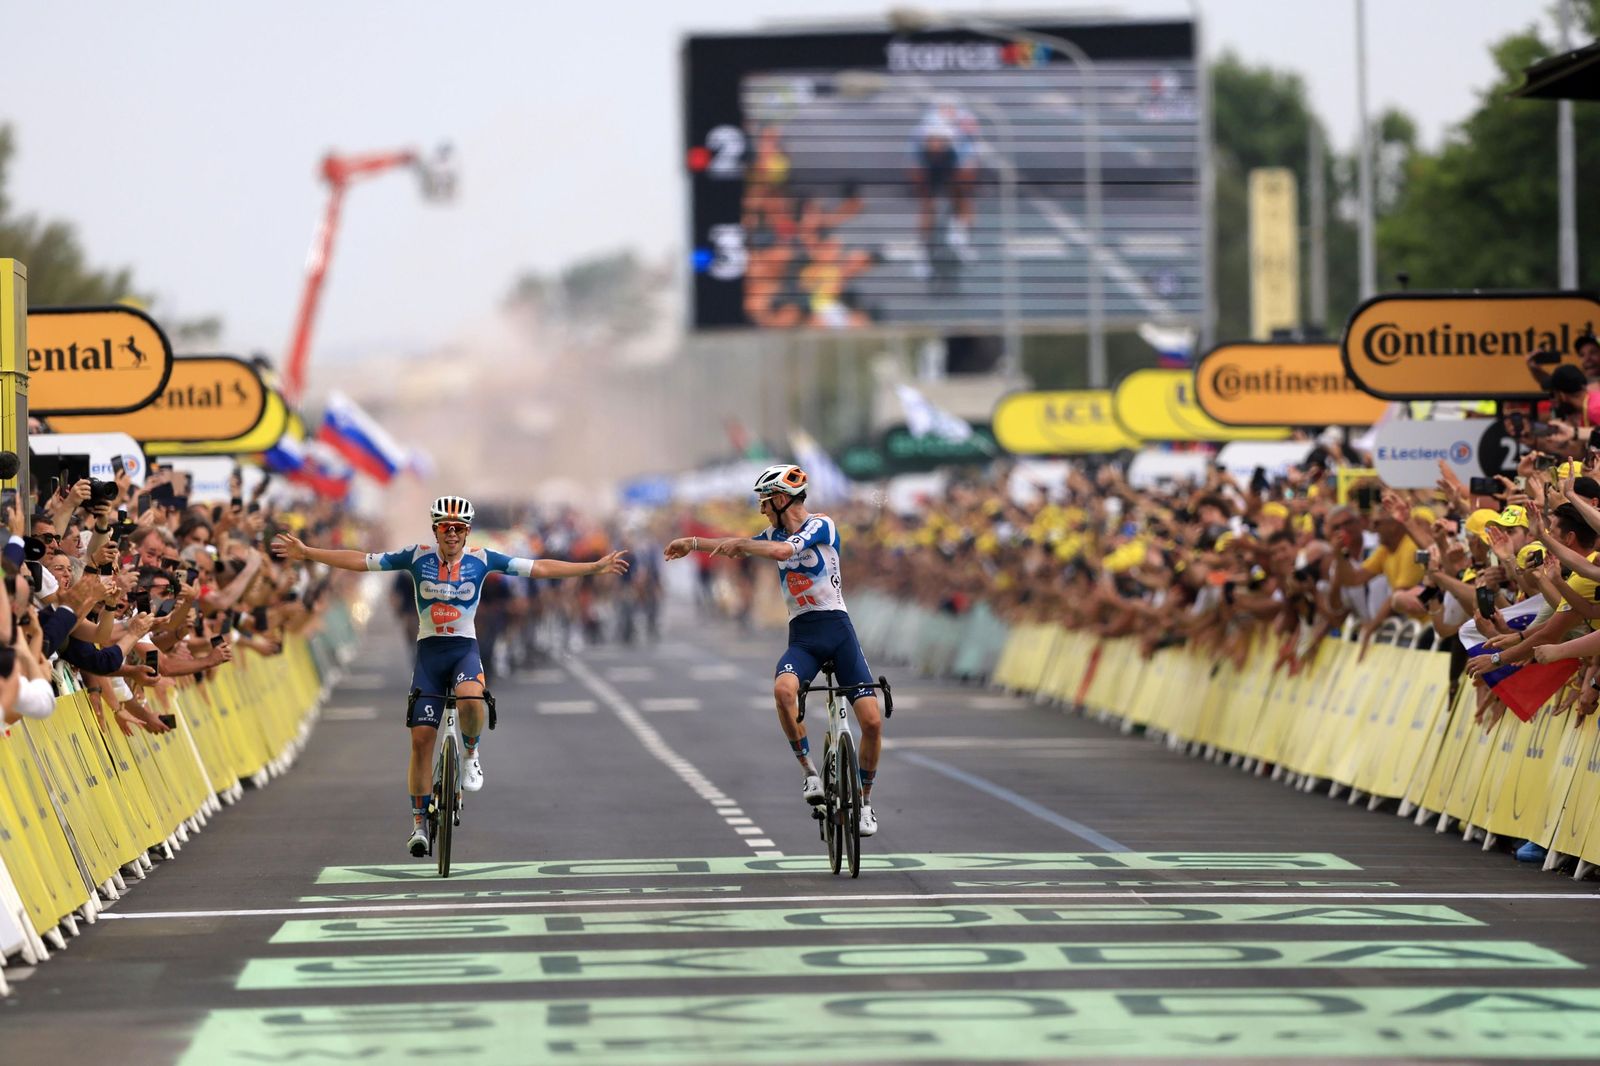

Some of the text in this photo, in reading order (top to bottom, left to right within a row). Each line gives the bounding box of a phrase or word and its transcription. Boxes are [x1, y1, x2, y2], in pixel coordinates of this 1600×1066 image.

[706, 126, 745, 175] 2
[709, 226, 747, 279] 3
[27, 338, 114, 372] ental
[1363, 321, 1570, 366] Continental
[319, 906, 1466, 938] SKODA
[294, 944, 1547, 983] SKODA
